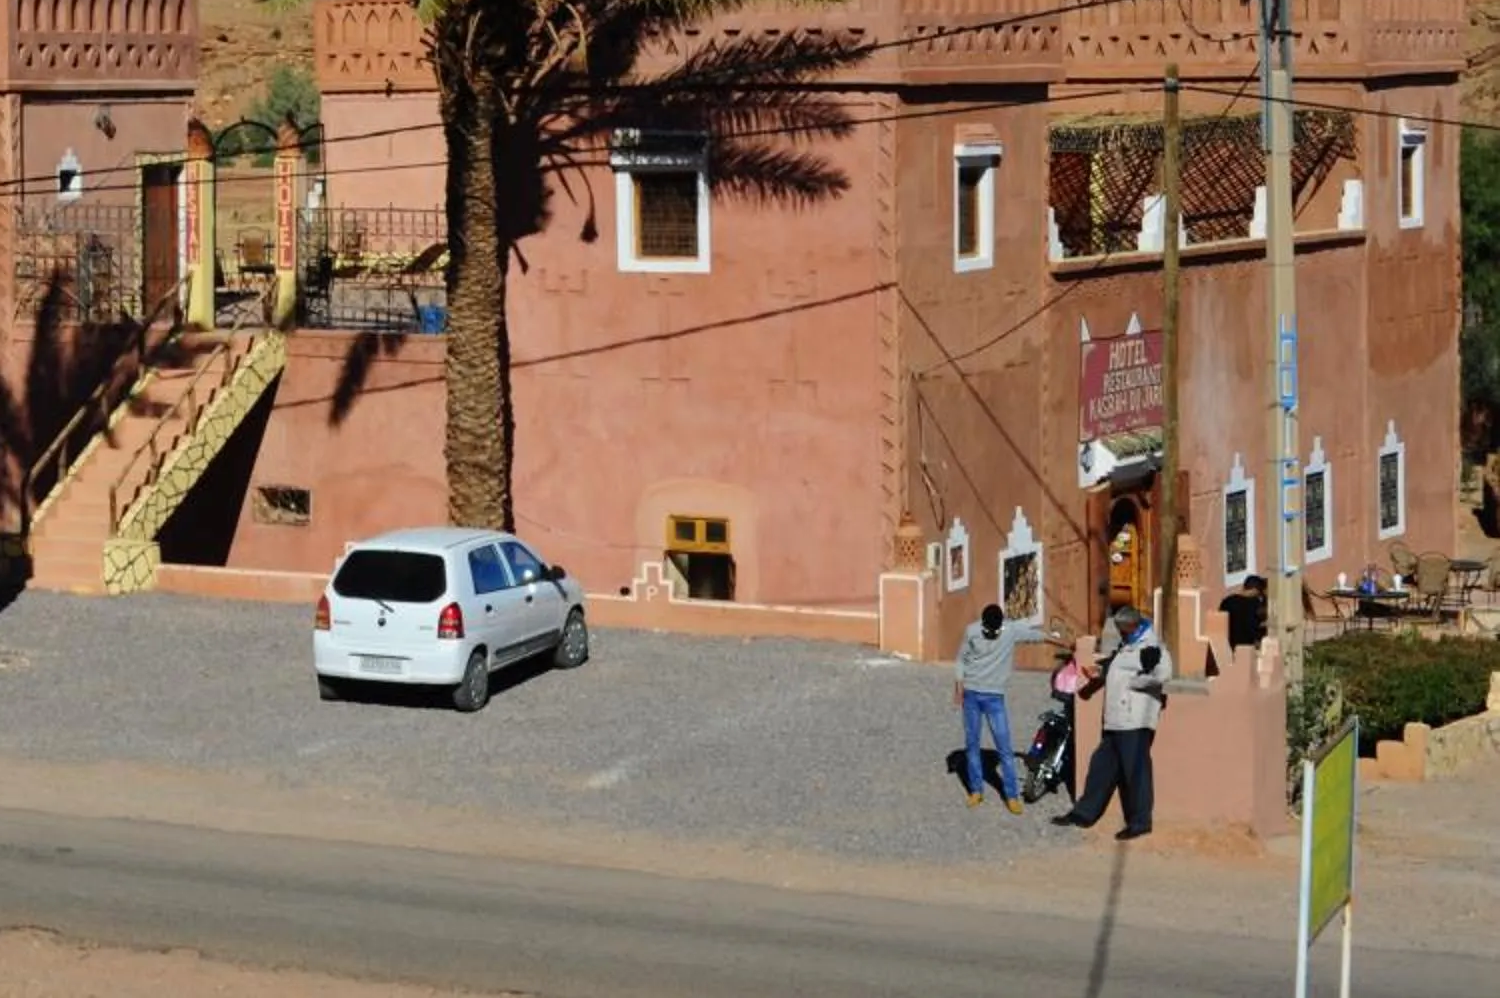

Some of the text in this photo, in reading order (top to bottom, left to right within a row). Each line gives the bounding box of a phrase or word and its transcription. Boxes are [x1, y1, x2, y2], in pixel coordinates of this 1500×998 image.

[278, 161, 293, 268] HOTEL
[1108, 339, 1148, 370] HOTEL
[1103, 363, 1162, 395] RESTAURANT
